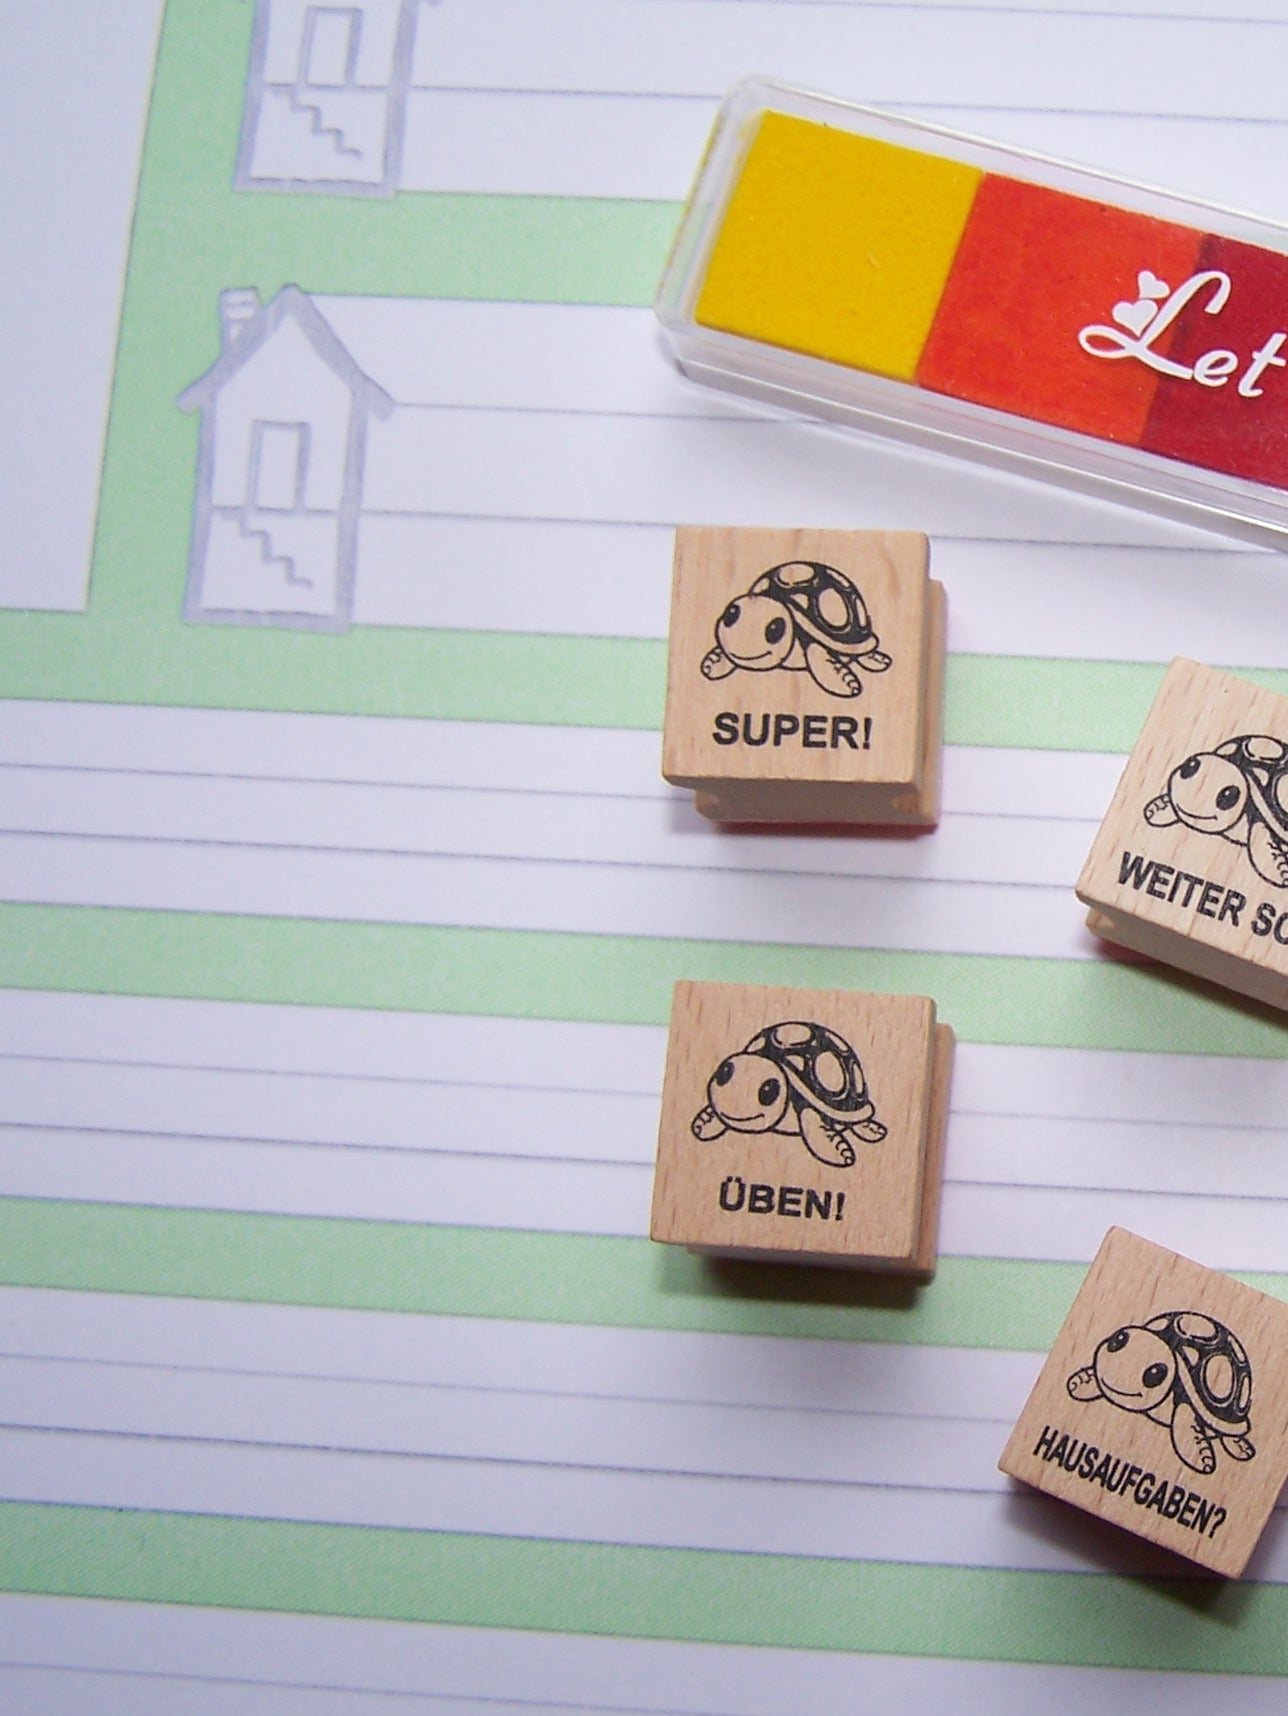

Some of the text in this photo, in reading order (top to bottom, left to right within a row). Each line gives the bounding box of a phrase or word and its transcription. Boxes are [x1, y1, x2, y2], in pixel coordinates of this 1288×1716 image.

[712, 711, 873, 750] SUPER!
[1117, 851, 1247, 927] WEITER
[719, 1176, 846, 1221] ÜBEN!
[1032, 1425, 1228, 1539] HAUSAUFGABEN?
